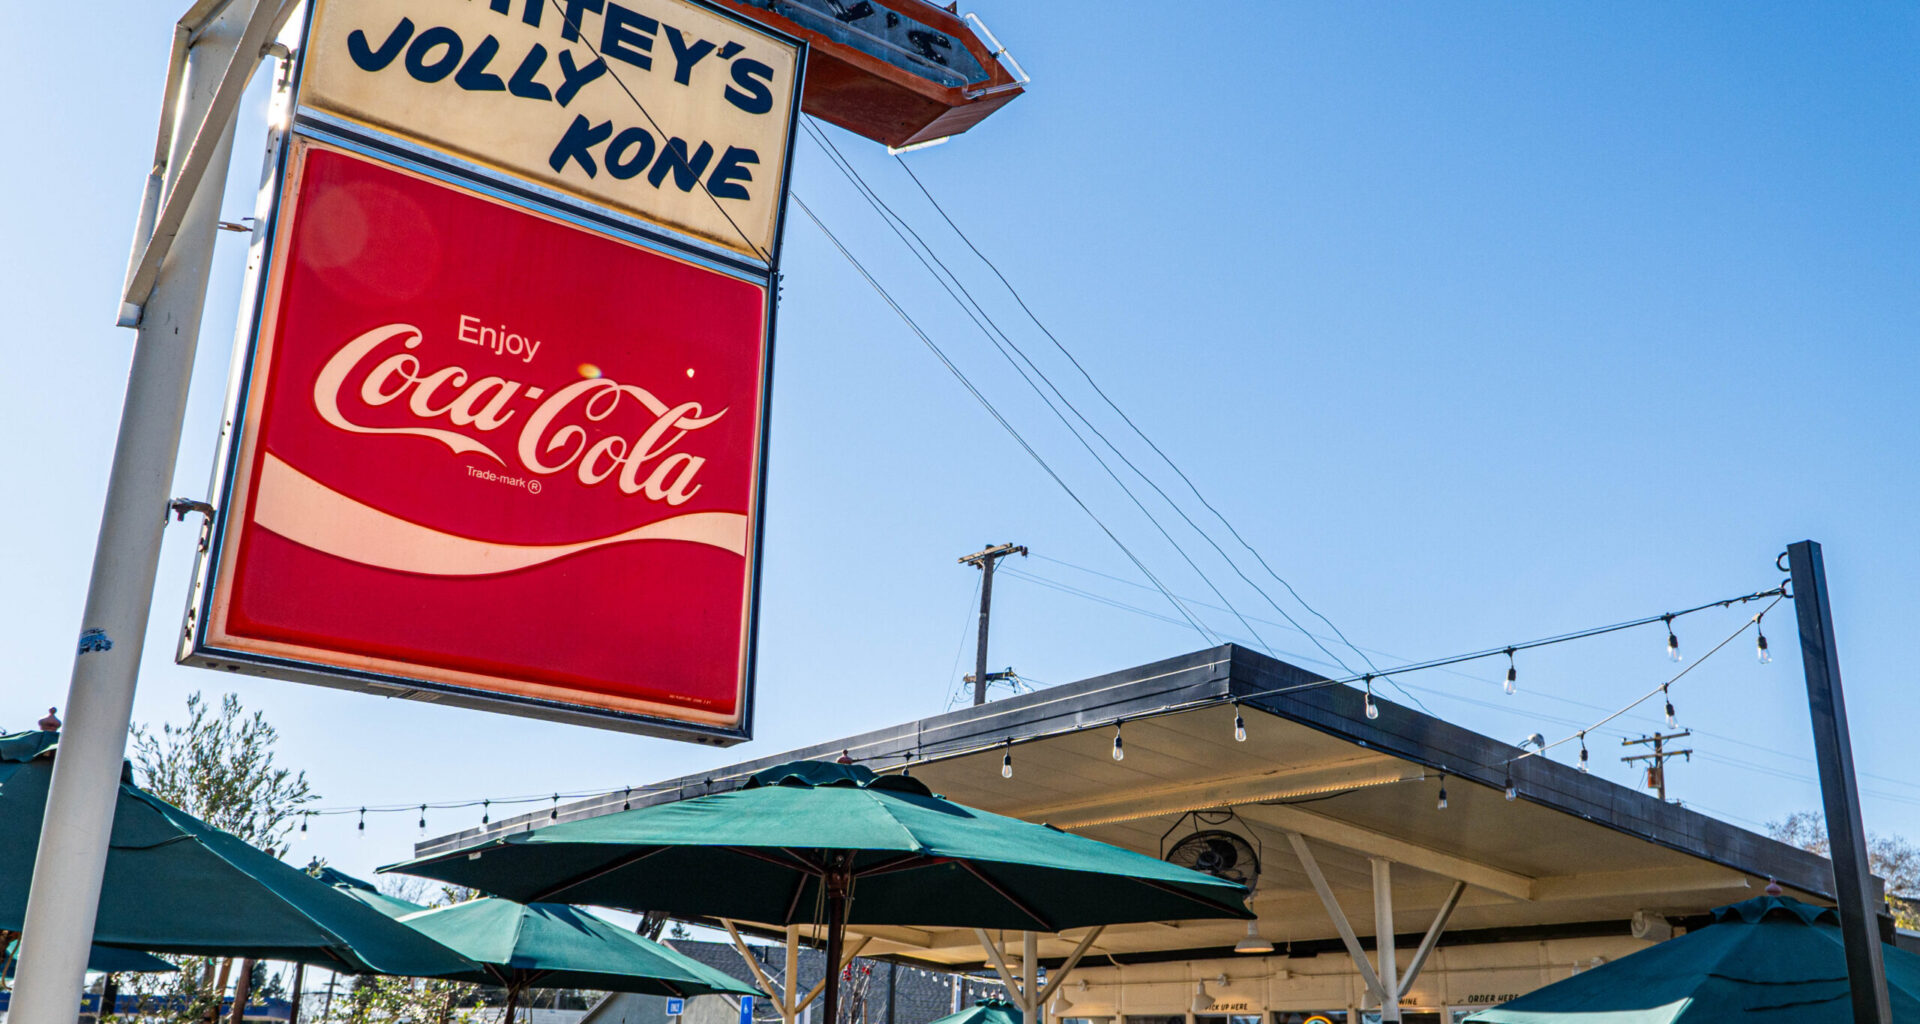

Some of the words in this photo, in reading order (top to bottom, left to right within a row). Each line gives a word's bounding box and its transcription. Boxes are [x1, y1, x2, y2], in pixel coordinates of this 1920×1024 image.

[347, 17, 607, 107] JOLLY
[549, 114, 760, 201] KONE
[457, 314, 541, 363] Enjoy
[314, 323, 729, 506] Coca-Cola
